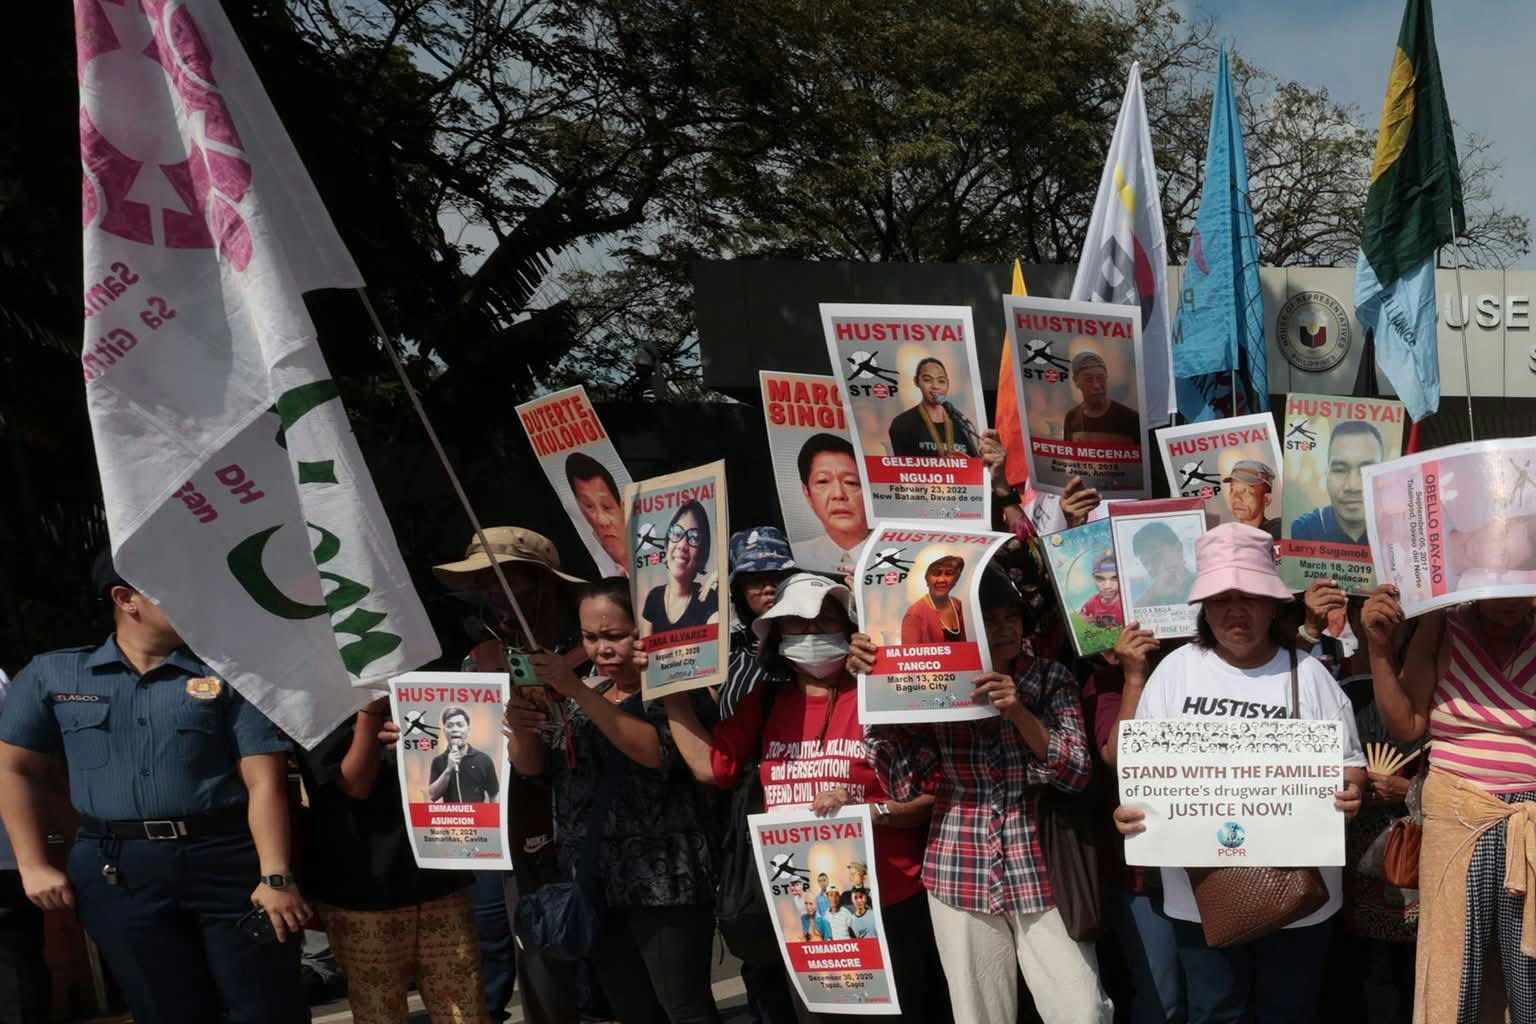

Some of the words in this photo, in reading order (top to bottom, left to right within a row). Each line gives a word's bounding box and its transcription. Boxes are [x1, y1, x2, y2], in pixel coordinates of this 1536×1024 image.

[836, 323, 964, 342] HUSTISYA!
[1017, 313, 1133, 339] HUSTISYA!
[849, 384, 898, 399] STOP
[1288, 400, 1403, 424] HUSTISYA!
[531, 408, 605, 456] IKULONG!
[1032, 442, 1073, 456] PETER
[1077, 447, 1140, 460] MECENAS
[882, 457, 968, 468] GELEJURAINE
[900, 473, 944, 484] NGUJO
[889, 485, 929, 495] February
[931, 485, 944, 495] 23,
[946, 484, 967, 494] 2022
[1426, 474, 1438, 529] OBELLO
[880, 532, 998, 545] HUSTISYA!
[1299, 559, 1327, 571] March
[1330, 560, 1345, 573] 18,
[1348, 563, 1372, 574] 2019
[1429, 533, 1443, 585] BAY-AO
[886, 649, 901, 658] MA
[903, 646, 951, 657] LOURDES
[897, 661, 941, 671] TANGCO
[888, 675, 914, 684] March
[916, 674, 930, 684] 13,
[933, 673, 955, 683] 2020
[896, 683, 926, 693] Baguio
[930, 682, 948, 693] City
[397, 688, 503, 704] HUSTISYA!
[826, 739, 866, 759] KILLINGS
[771, 765, 785, 780] and
[786, 759, 850, 780] PERSECUTION!
[1121, 766, 1178, 780] STAND
[1182, 765, 1227, 780] WITH
[1231, 765, 1262, 779] THE
[1265, 764, 1341, 779] FAMILIES
[1125, 784, 1140, 798] of
[1214, 784, 1277, 801] drugwar
[1281, 783, 1339, 801] Killings!
[428, 804, 475, 813] EMMANUEL
[1168, 802, 1236, 820] JUSTICE
[1241, 803, 1293, 817] NOW!
[431, 817, 475, 825] ASUNCION
[760, 823, 863, 846] HUSTISYA!
[1217, 848, 1247, 857] PCPR
[802, 943, 859, 955] TUMANDOK
[808, 958, 861, 969] MASSACRE
